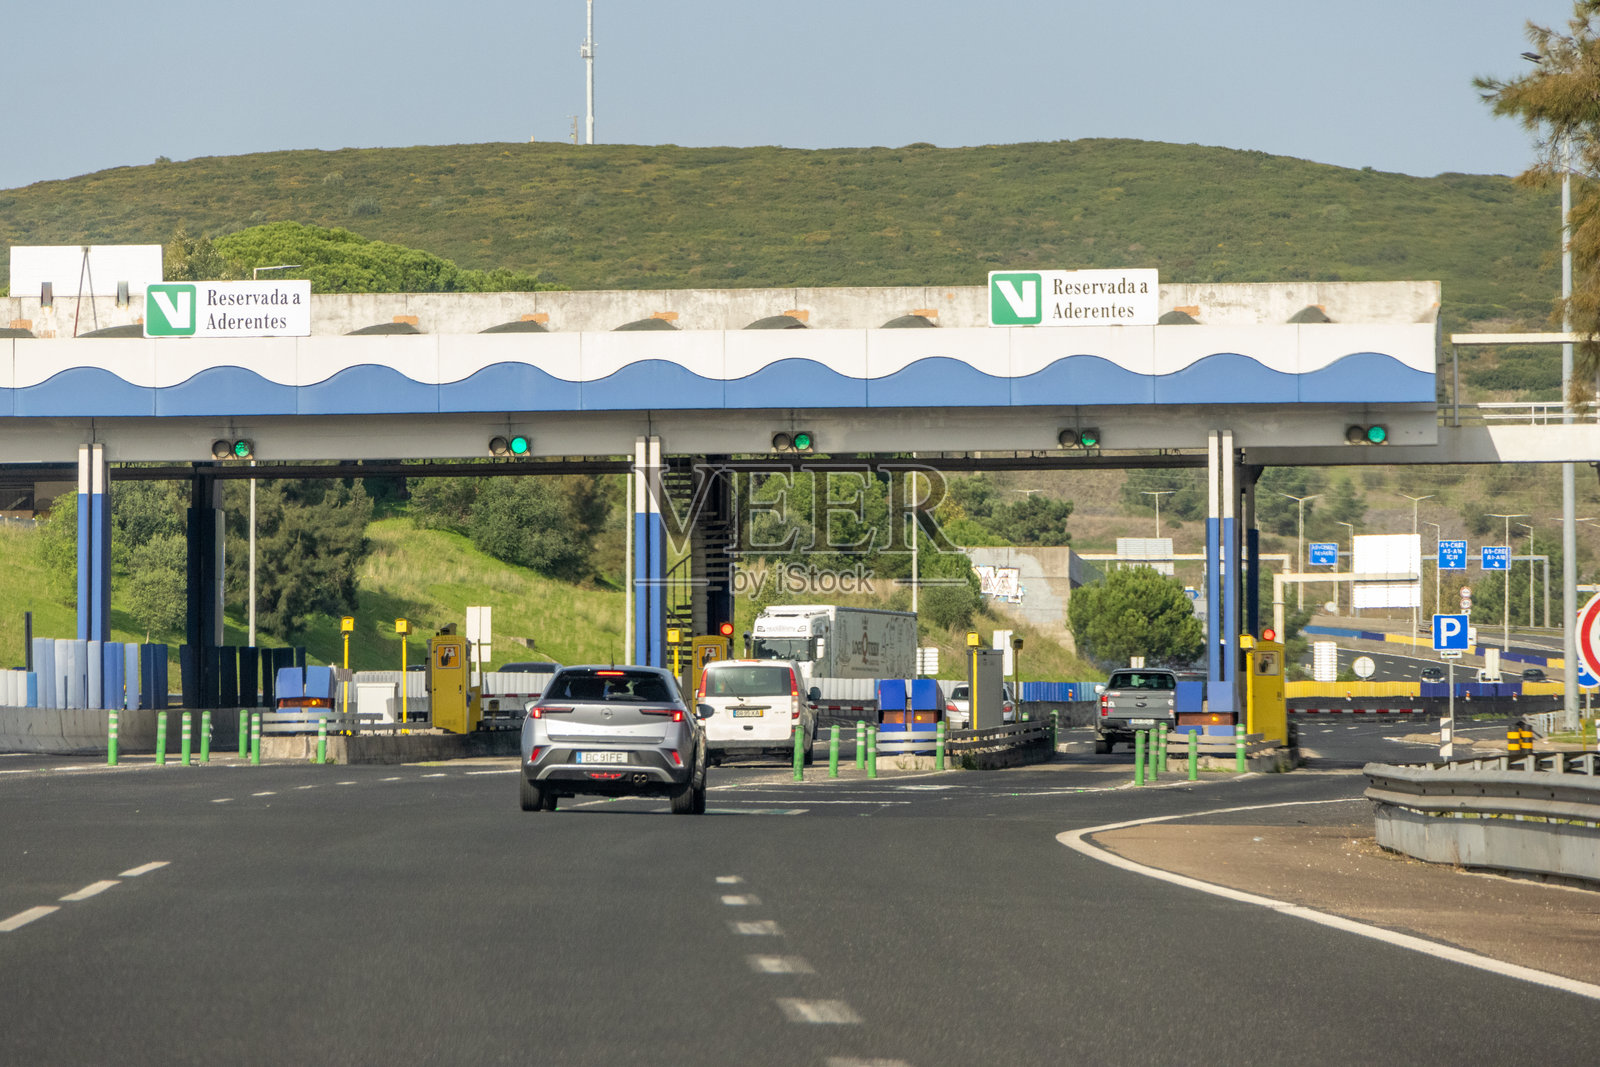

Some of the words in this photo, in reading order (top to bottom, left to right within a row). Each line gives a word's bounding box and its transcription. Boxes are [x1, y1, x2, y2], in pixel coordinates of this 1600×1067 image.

[1053, 277, 1135, 295] Reservada
[1140, 282, 1148, 294] a
[207, 288, 288, 306] Reservada
[293, 293, 301, 305] a
[1052, 302, 1134, 319] Aderentes
[206, 313, 287, 330] Aderentes
[1440, 617, 1461, 647] P
